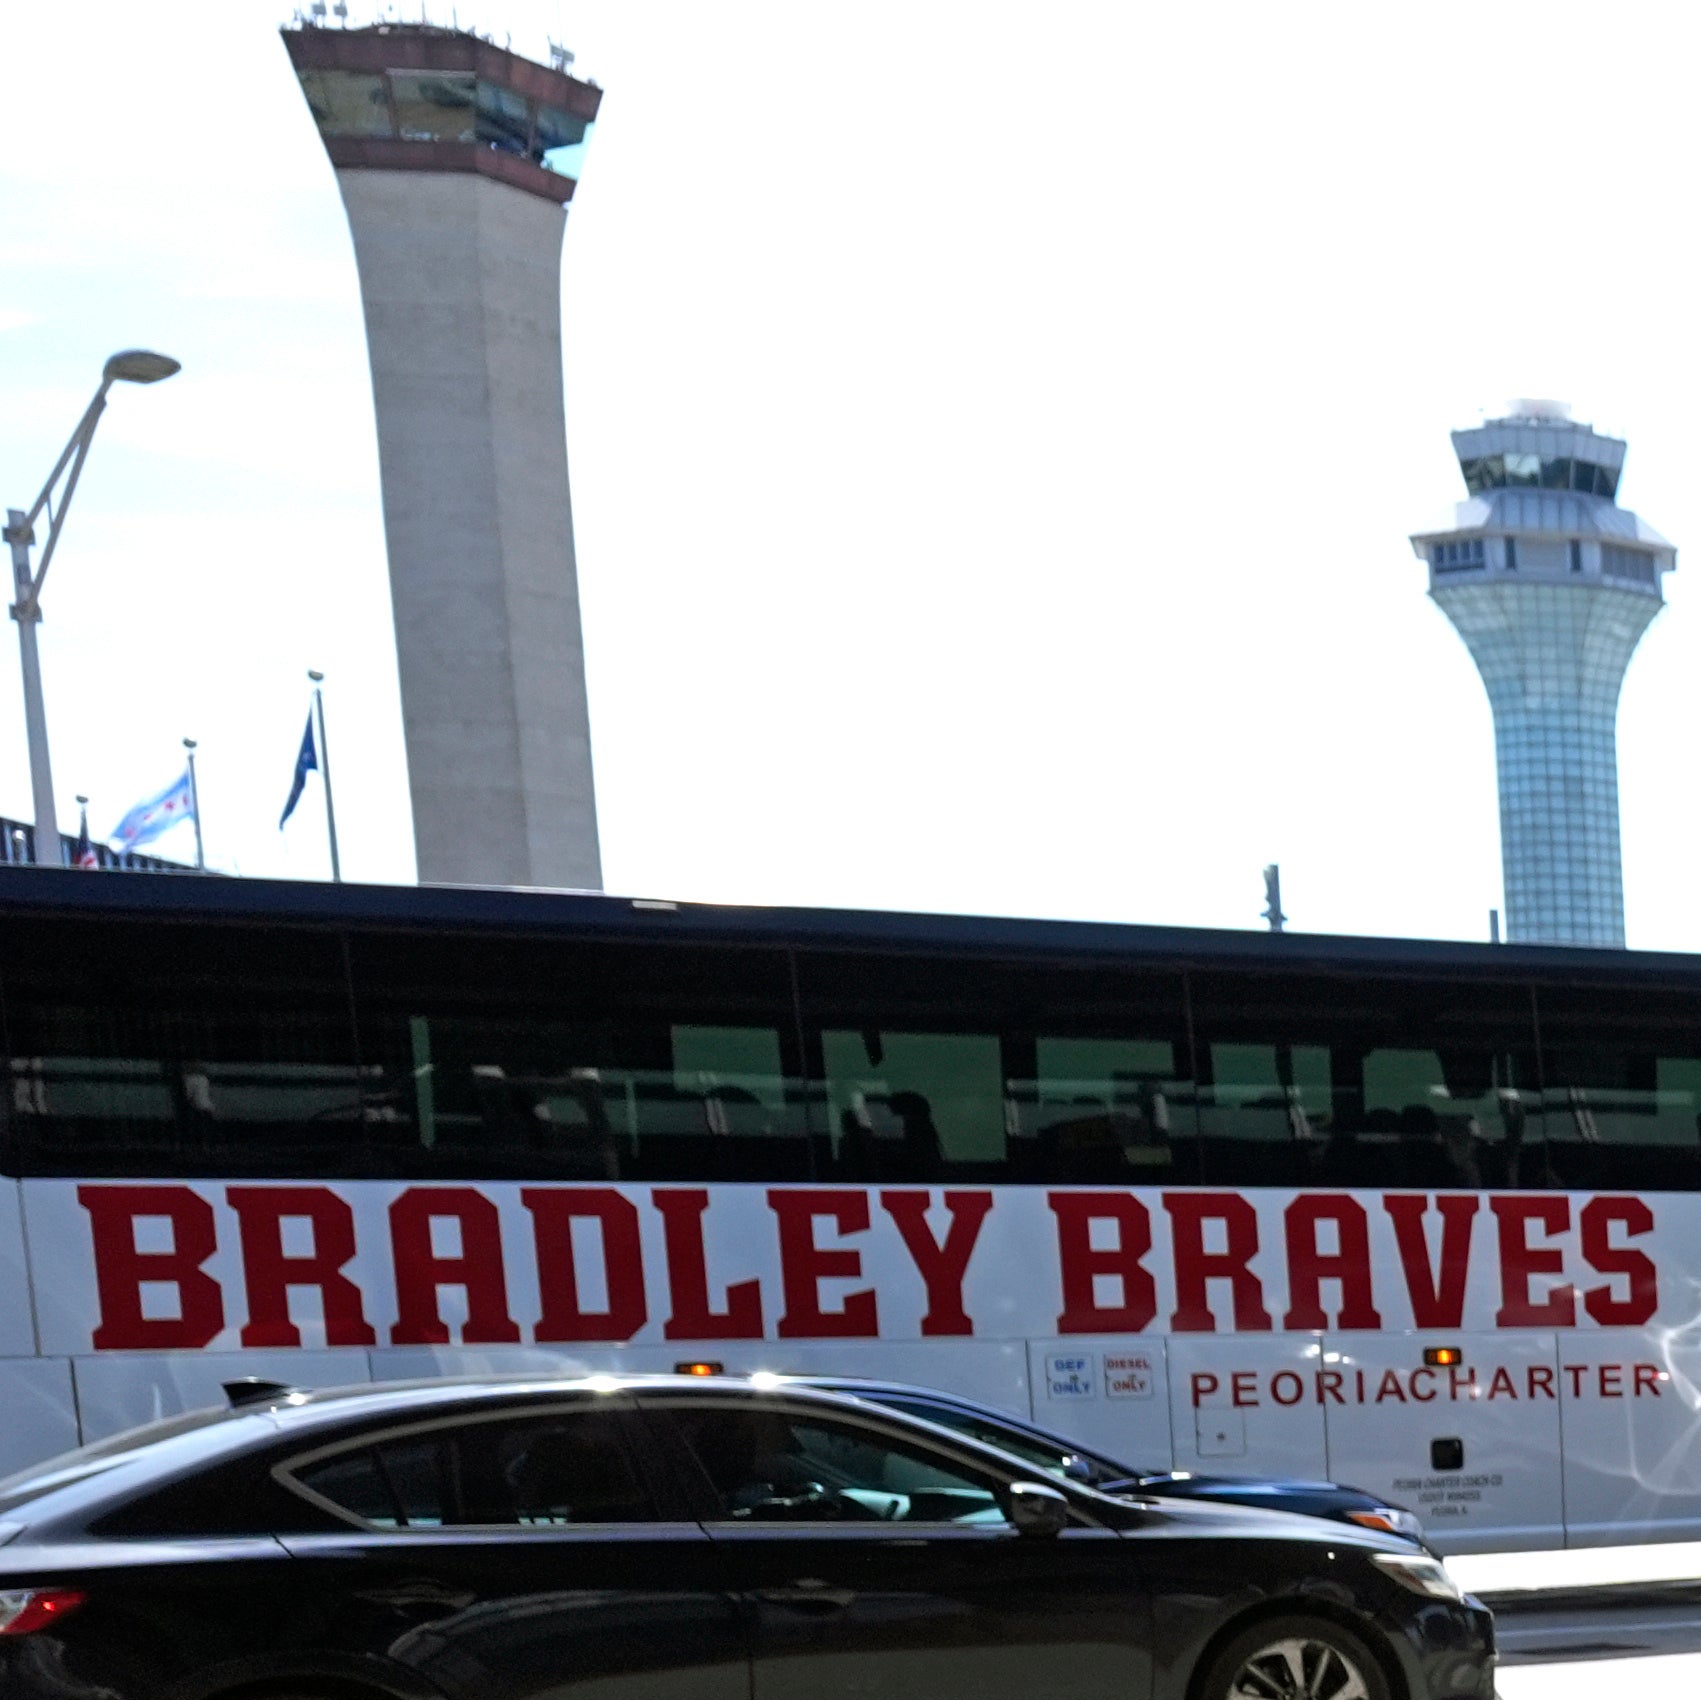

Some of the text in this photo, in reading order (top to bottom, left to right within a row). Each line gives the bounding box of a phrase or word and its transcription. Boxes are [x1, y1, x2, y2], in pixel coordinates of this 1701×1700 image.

[77, 1186, 1658, 1350] BRADLEY BRAVES
[1107, 1359, 1150, 1370] DIESEL
[1053, 1381, 1090, 1394] ONLY
[1113, 1380, 1146, 1392] ONLY
[1190, 1365, 1660, 1409] PEORIACHARTER
